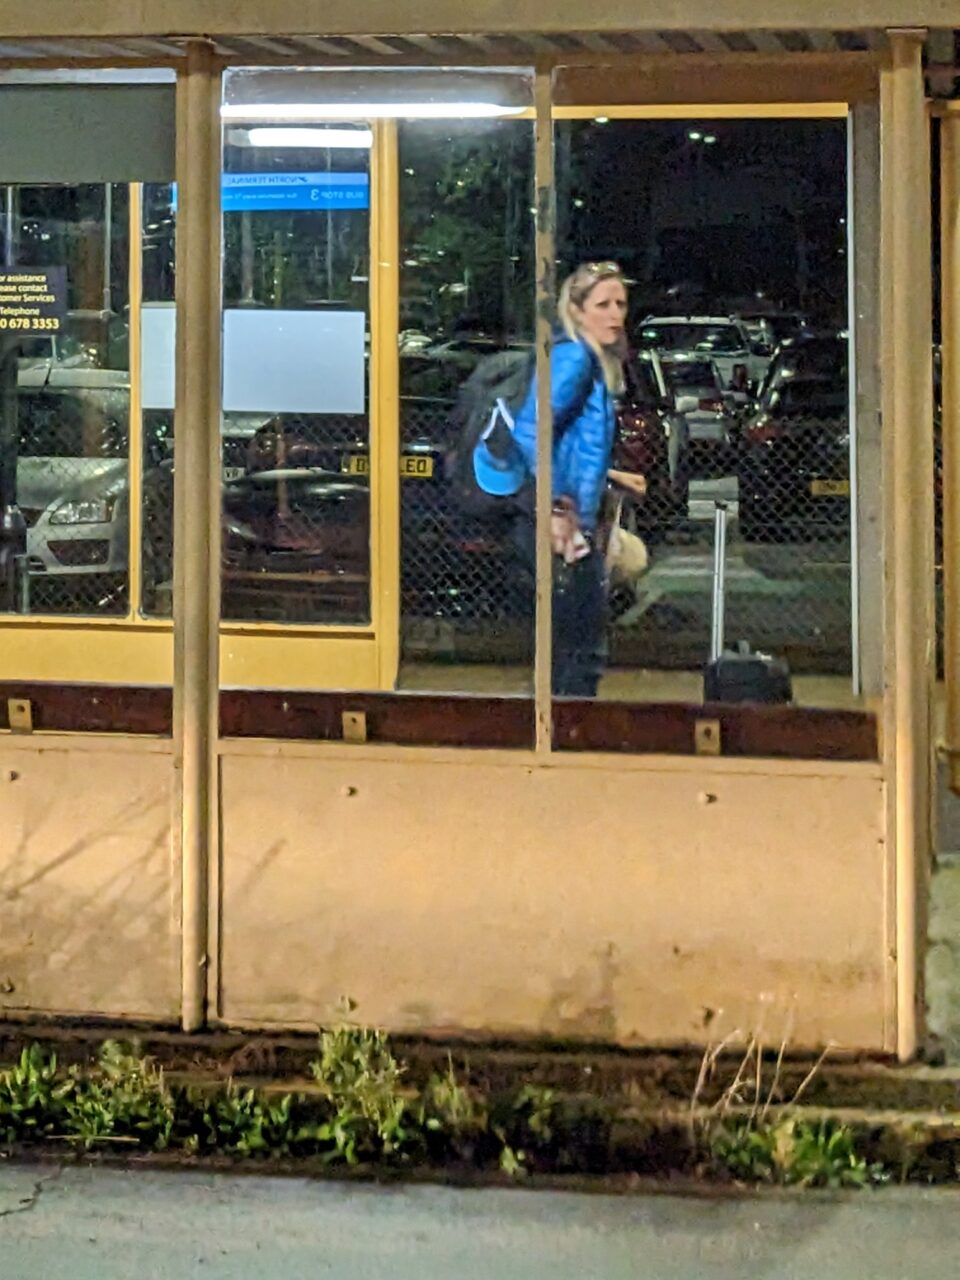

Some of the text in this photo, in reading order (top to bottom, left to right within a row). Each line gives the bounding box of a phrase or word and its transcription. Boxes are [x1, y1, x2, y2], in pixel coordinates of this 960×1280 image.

[7, 274, 47, 282] assistance
[18, 283, 48, 293] contact
[22, 293, 56, 303] Services
[0, 306, 40, 316] Telephone
[8, 318, 30, 329] 678
[31, 318, 59, 329] 3353
